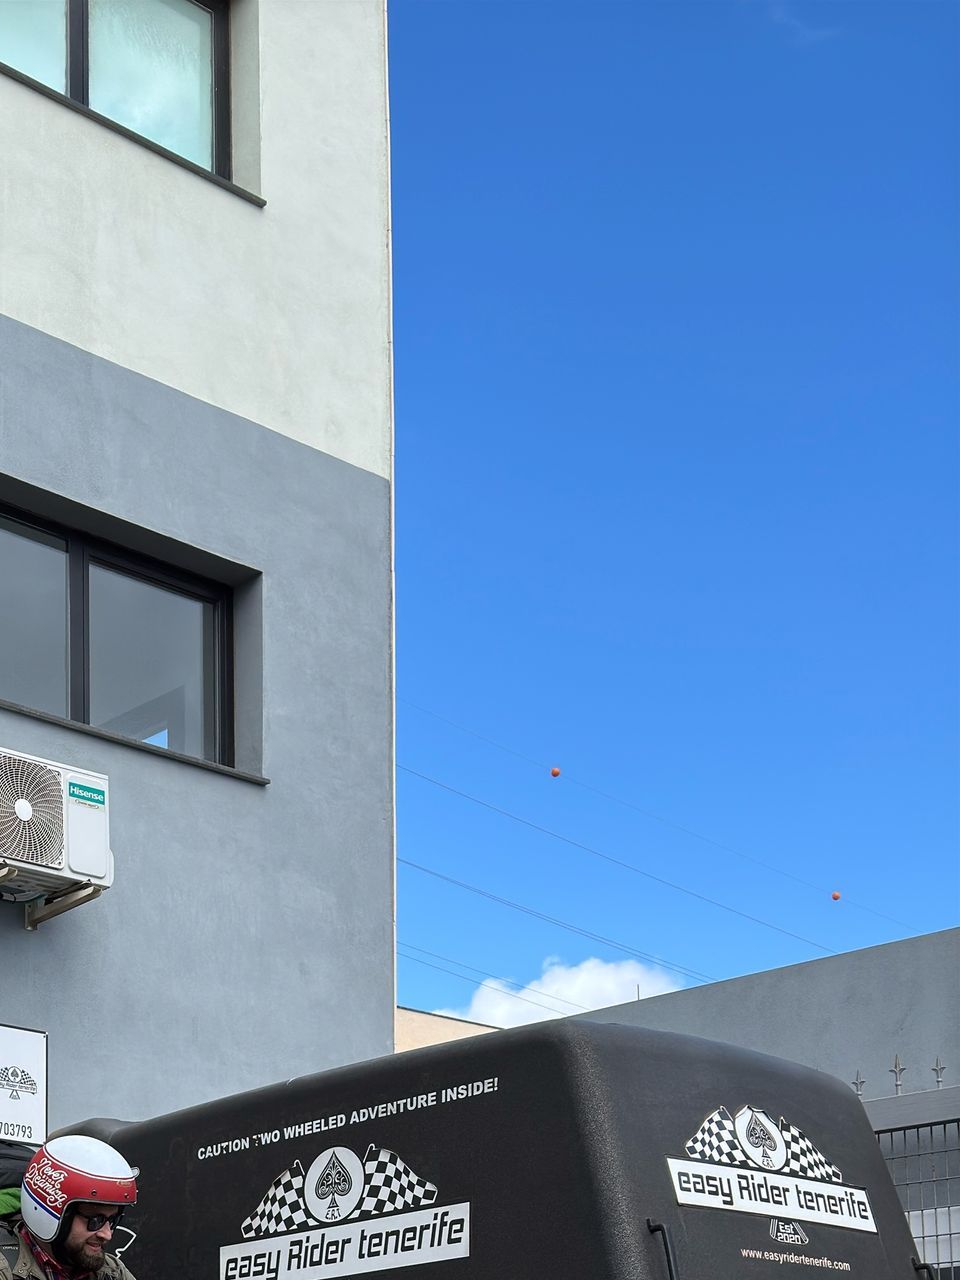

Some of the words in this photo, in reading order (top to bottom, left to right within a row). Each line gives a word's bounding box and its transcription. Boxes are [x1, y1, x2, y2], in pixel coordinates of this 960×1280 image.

[70, 785, 104, 801] Hisense
[197, 1137, 250, 1160] CAUTION
[283, 1114, 347, 1140] WHEELED
[349, 1092, 437, 1125] ADVENTURE
[441, 1077, 499, 1104] INSIDE!
[677, 1171, 734, 1206] easy
[737, 1174, 790, 1206] Rider
[795, 1184, 869, 1220] tenerife
[777, 1233, 801, 1245] 2020
[778, 1222, 794, 1234] Est
[287, 1233, 352, 1271] Rider
[358, 1211, 465, 1260] tenerife
[740, 1248, 851, 1272] www.easyridertenerife.com
